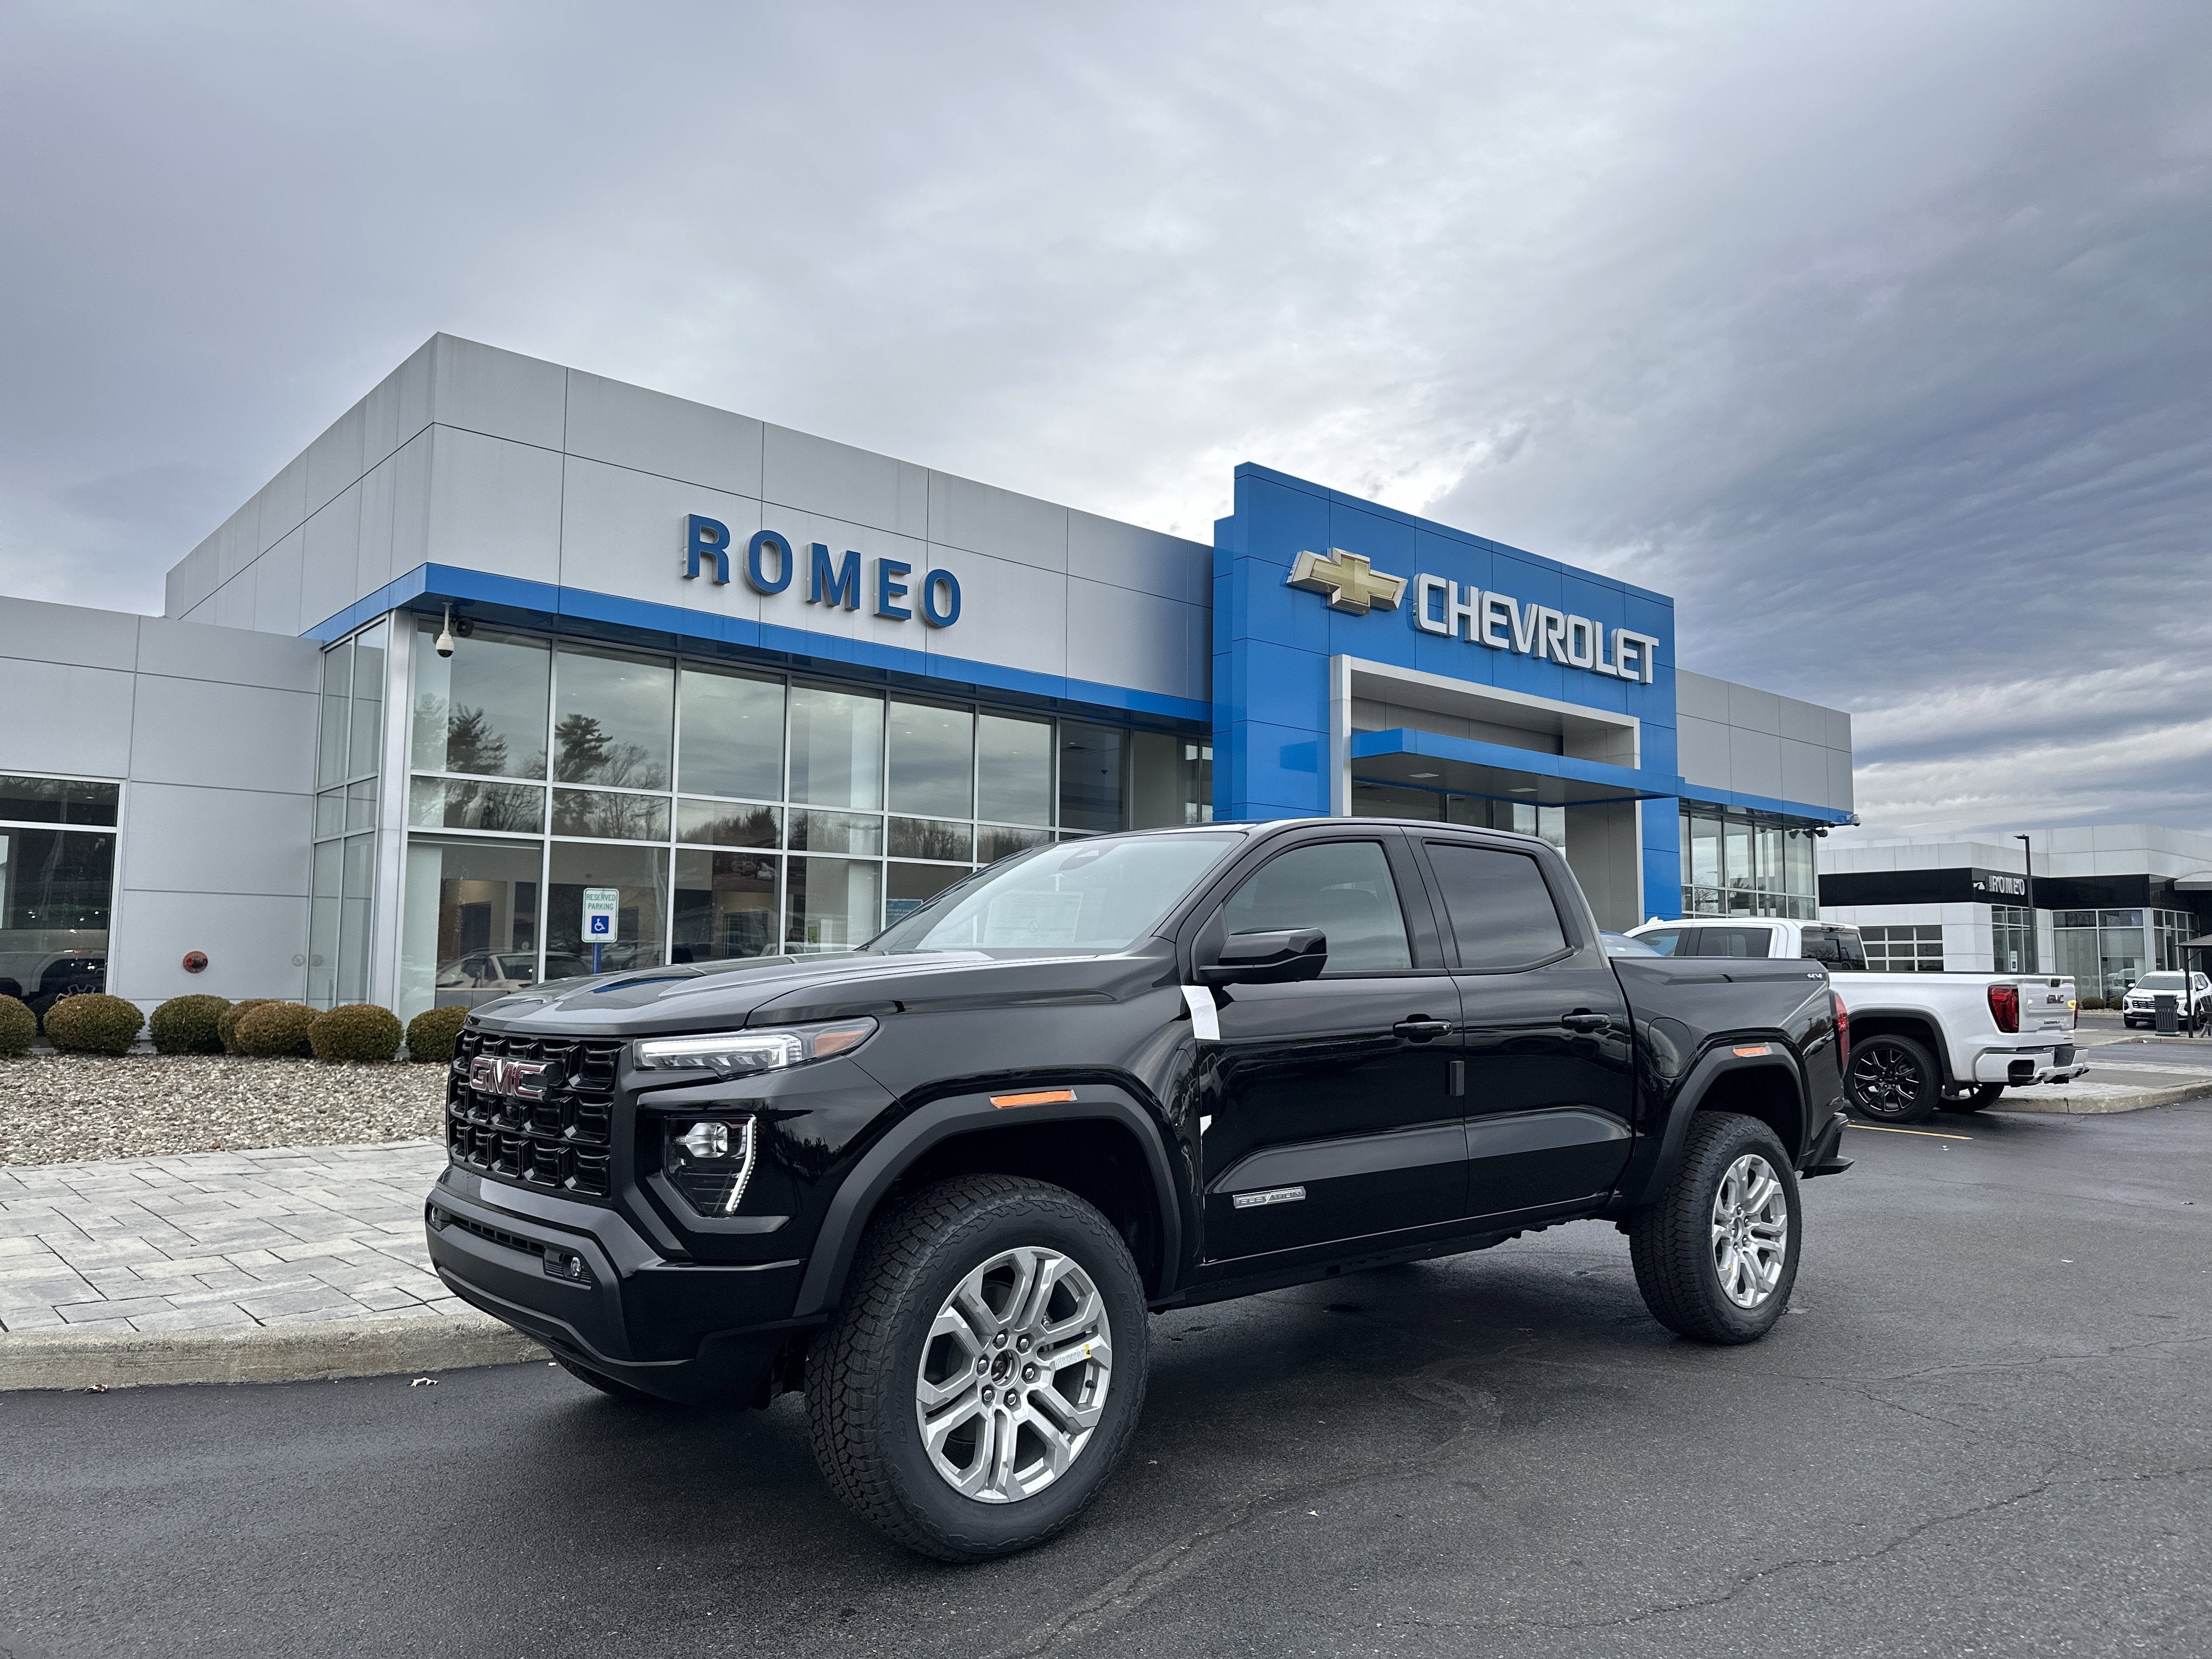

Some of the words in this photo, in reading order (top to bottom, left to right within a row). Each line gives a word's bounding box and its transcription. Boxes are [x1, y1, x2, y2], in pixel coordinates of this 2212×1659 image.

[683, 514, 961, 628] ROMEO
[1413, 573, 1659, 685] CHEVROLET
[1989, 876, 2025, 895] ROMEO
[470, 1057, 547, 1101] GMC
[1239, 1191, 1301, 1204] ELEVATION
[1099, 1291, 1136, 1467] BRIDGESTONE
